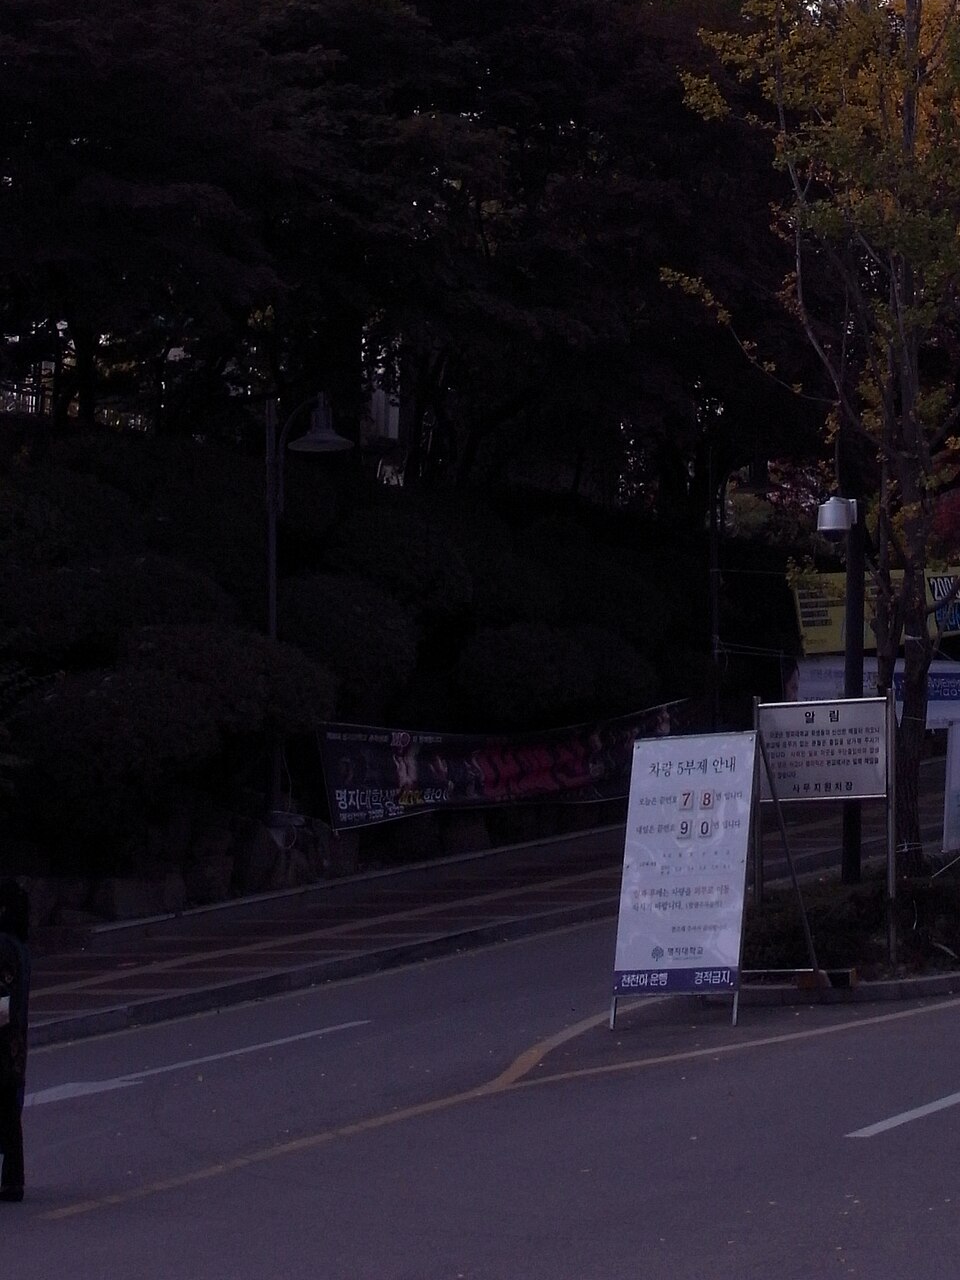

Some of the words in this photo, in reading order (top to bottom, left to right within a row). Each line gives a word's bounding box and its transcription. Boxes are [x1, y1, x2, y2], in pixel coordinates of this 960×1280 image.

[648, 761, 673, 778] 차량
[676, 758, 708, 776] 5부제
[712, 756, 736, 774] 안내
[682, 792, 691, 807] 7
[703, 792, 711, 807] 8
[680, 821, 688, 835] 9
[700, 821, 709, 835] 0
[667, 946, 704, 956] 명지대학교
[650, 973, 668, 986] 운행
[694, 970, 730, 985] 경적금지
